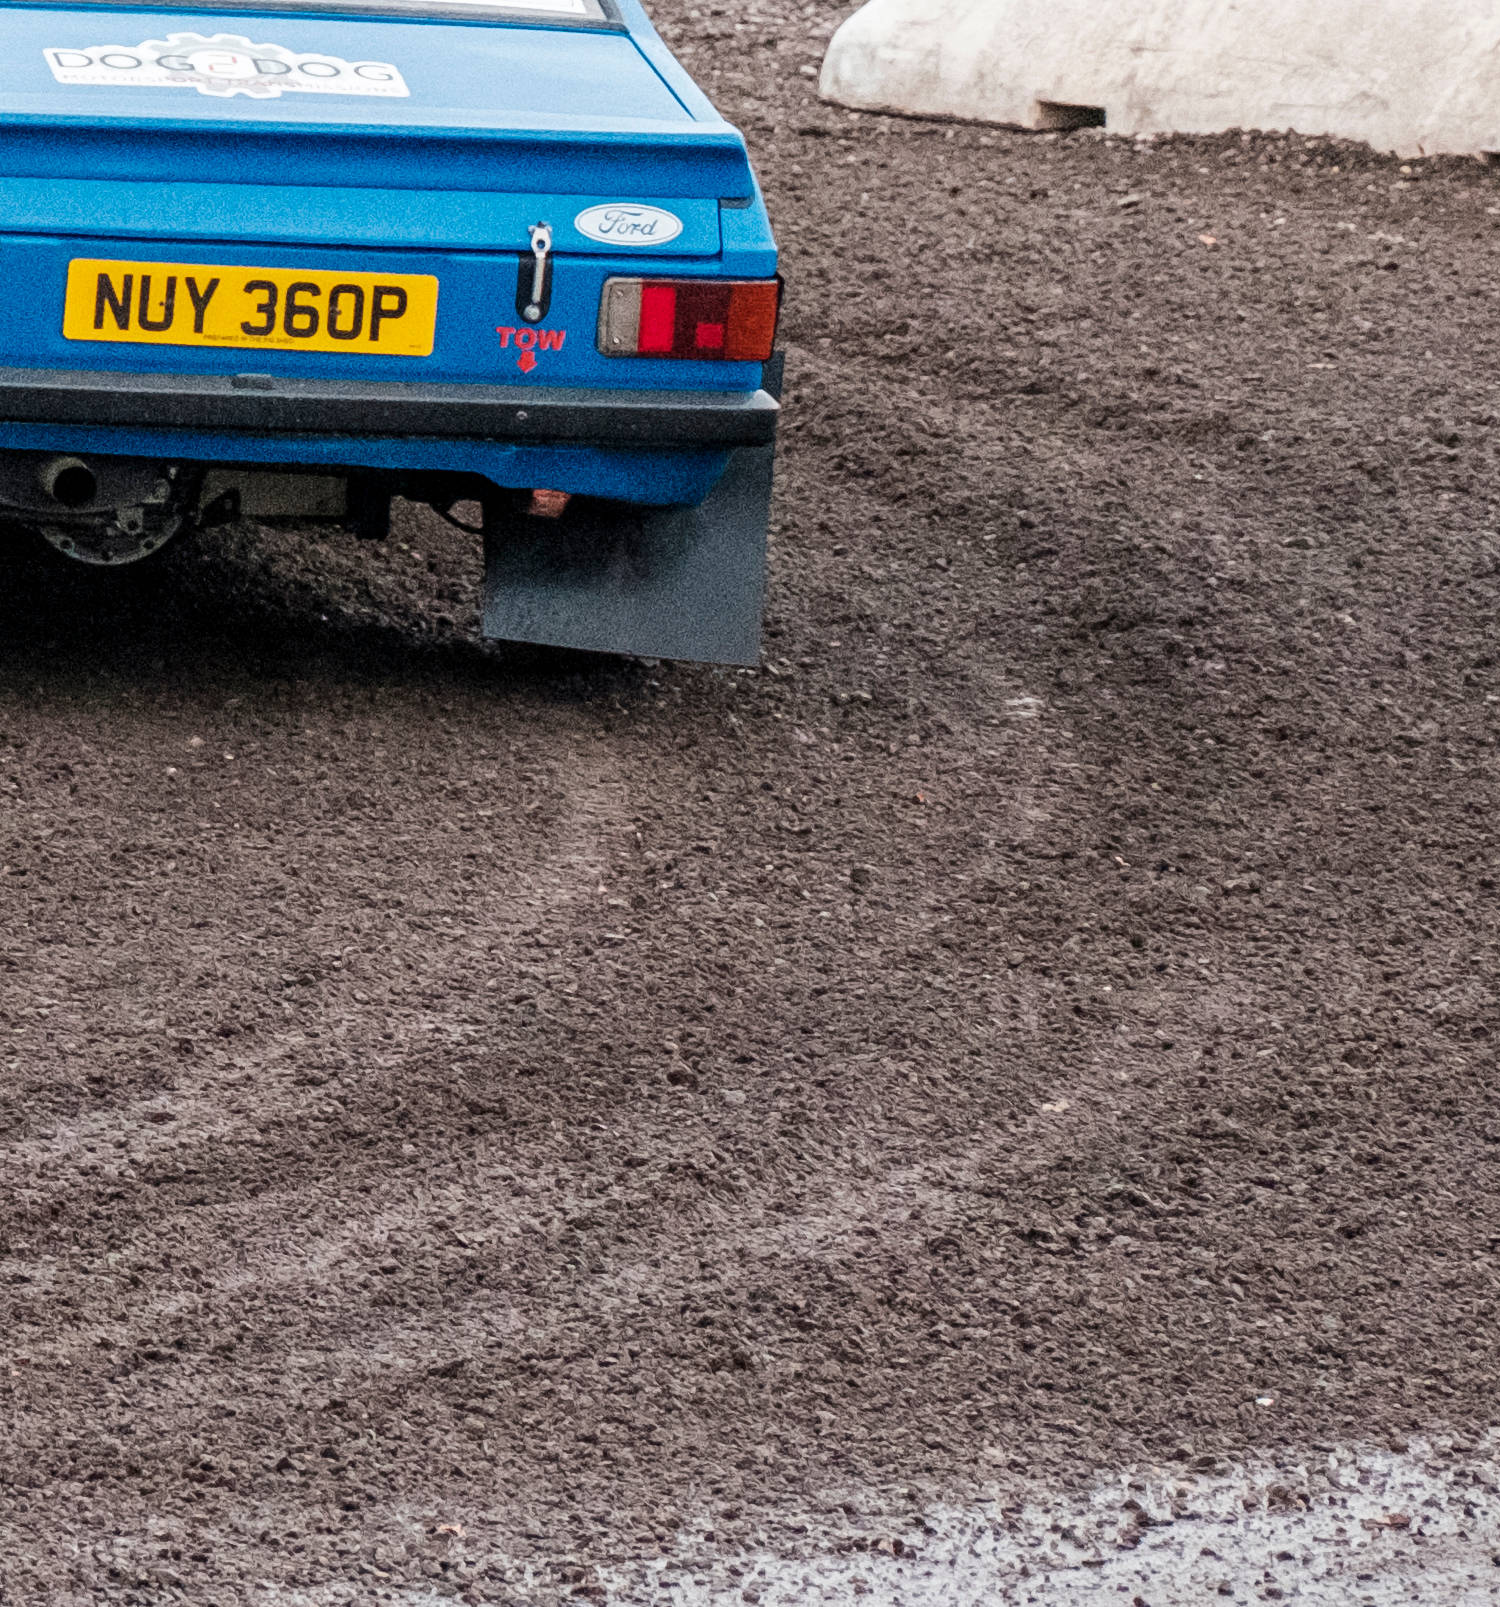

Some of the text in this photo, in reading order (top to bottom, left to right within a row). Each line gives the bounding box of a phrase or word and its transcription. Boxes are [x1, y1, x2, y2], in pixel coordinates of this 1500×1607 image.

[598, 209, 660, 237] Ford
[93, 272, 408, 342] NUY 360P
[495, 326, 566, 351] TOW
